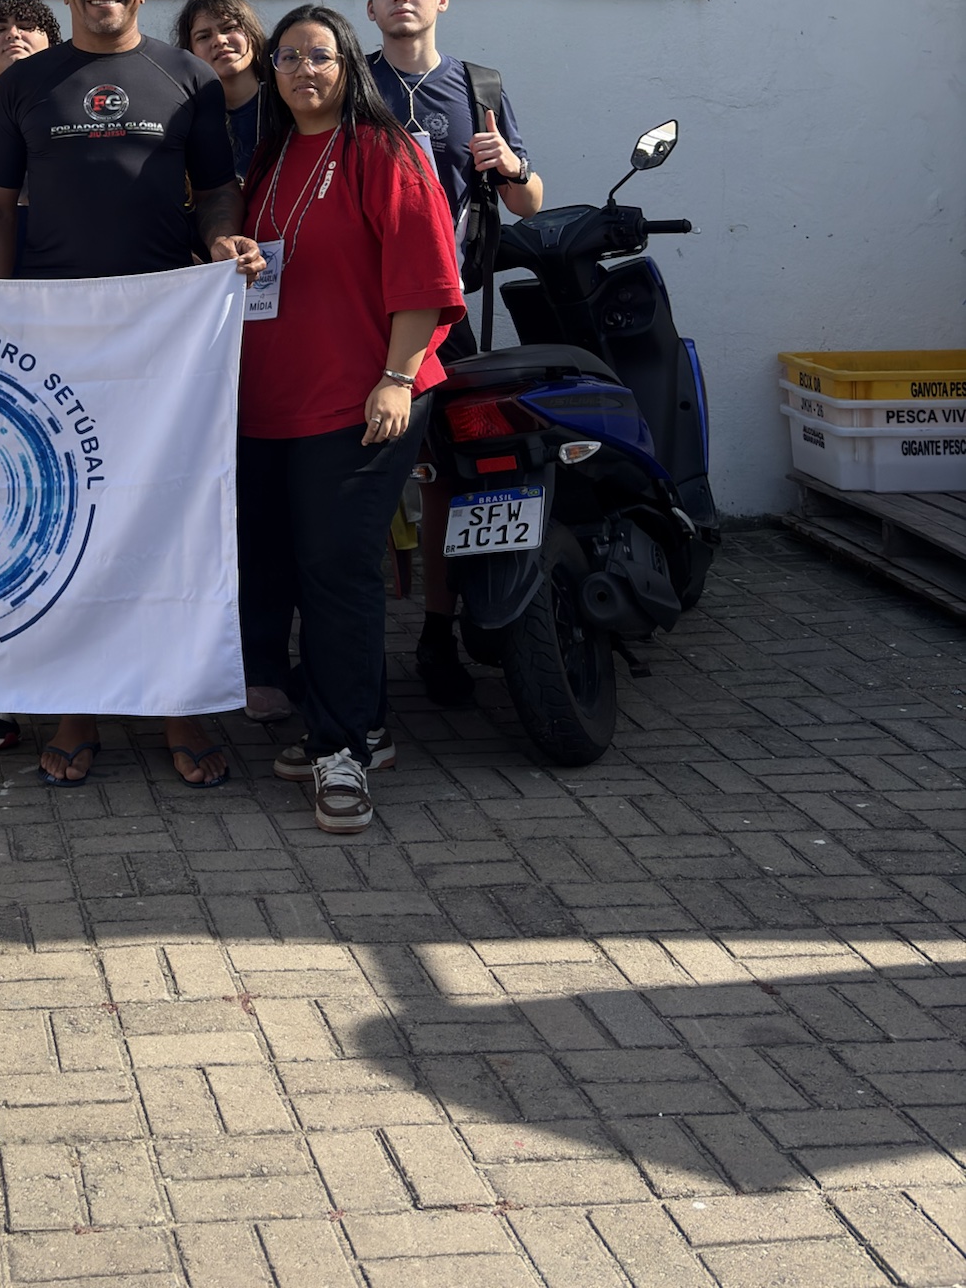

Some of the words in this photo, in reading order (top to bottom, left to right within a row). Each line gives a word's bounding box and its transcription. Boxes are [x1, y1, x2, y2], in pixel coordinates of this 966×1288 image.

[249, 301, 273, 312] MÍDIA
[799, 372, 814, 391] BOX
[911, 382, 948, 398] GAIVOTA
[886, 409, 939, 424] PESCA
[43, 373, 105, 490] SETÚBAL
[901, 439, 942, 456] GIGANTE
[943, 438, 966, 456] PESC
[478, 494, 513, 504] BRASIL
[469, 501, 522, 526] SFW
[456, 522, 529, 549] 1C12
[445, 545, 456, 553] BR
